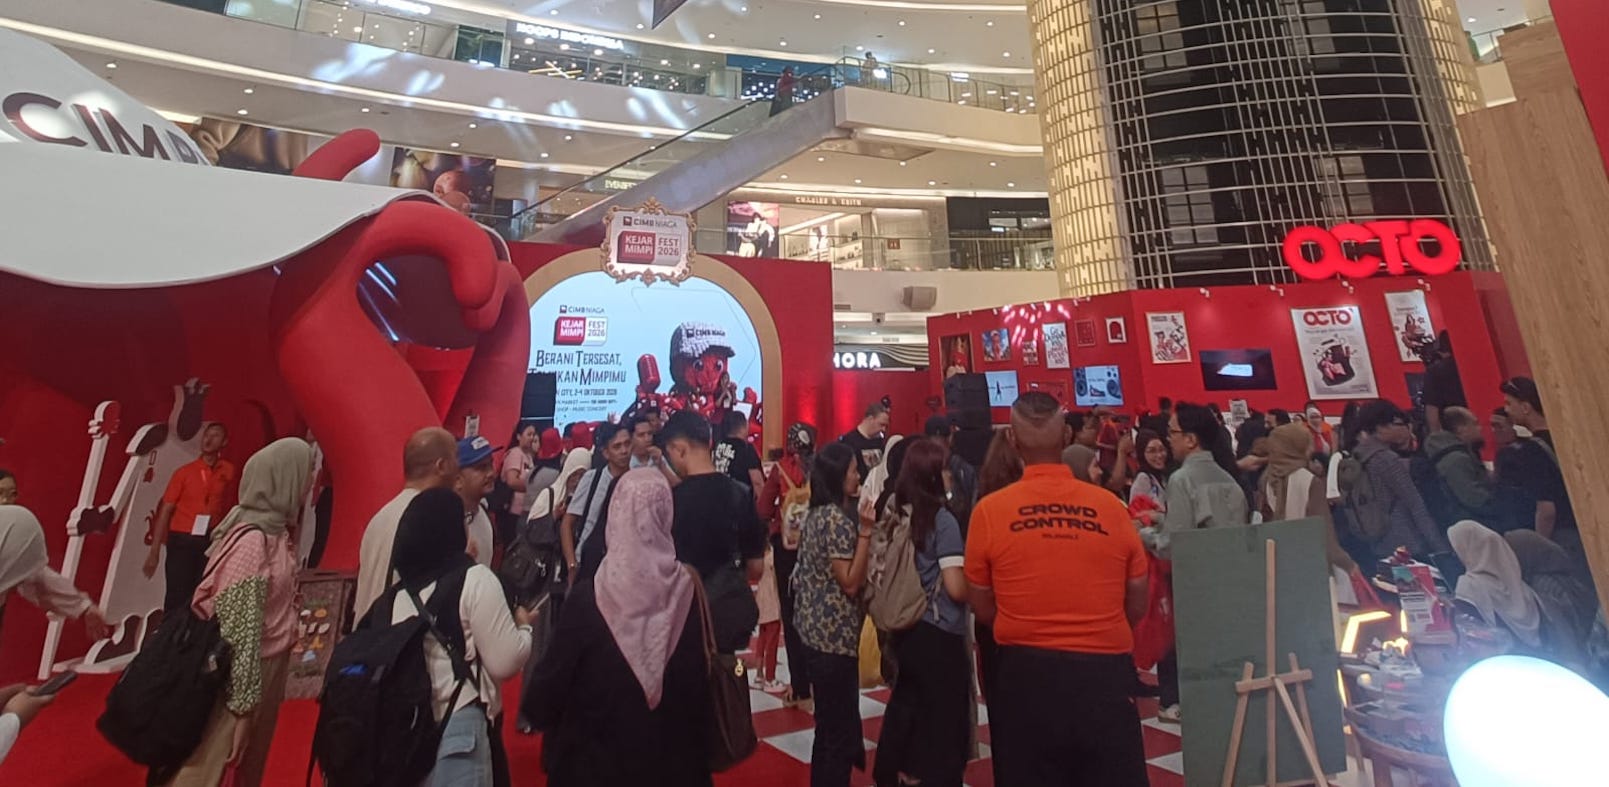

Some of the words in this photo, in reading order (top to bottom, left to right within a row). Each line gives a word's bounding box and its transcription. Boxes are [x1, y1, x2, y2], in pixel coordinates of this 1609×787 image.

[634, 218, 654, 226] CIMB
[655, 220, 677, 228] NIAGA
[625, 235, 653, 245] KEJAR
[658, 238, 679, 247] FEST
[624, 245, 653, 255] MIMPI
[658, 248, 679, 256] 2026
[1283, 218, 1461, 280] OCTO
[561, 320, 584, 328] KEJAR
[1303, 310, 1351, 326] OCTO
[560, 328, 583, 337] MIMPI
[1018, 504, 1098, 518] CROWD
[1010, 517, 1109, 536] CONTROL
